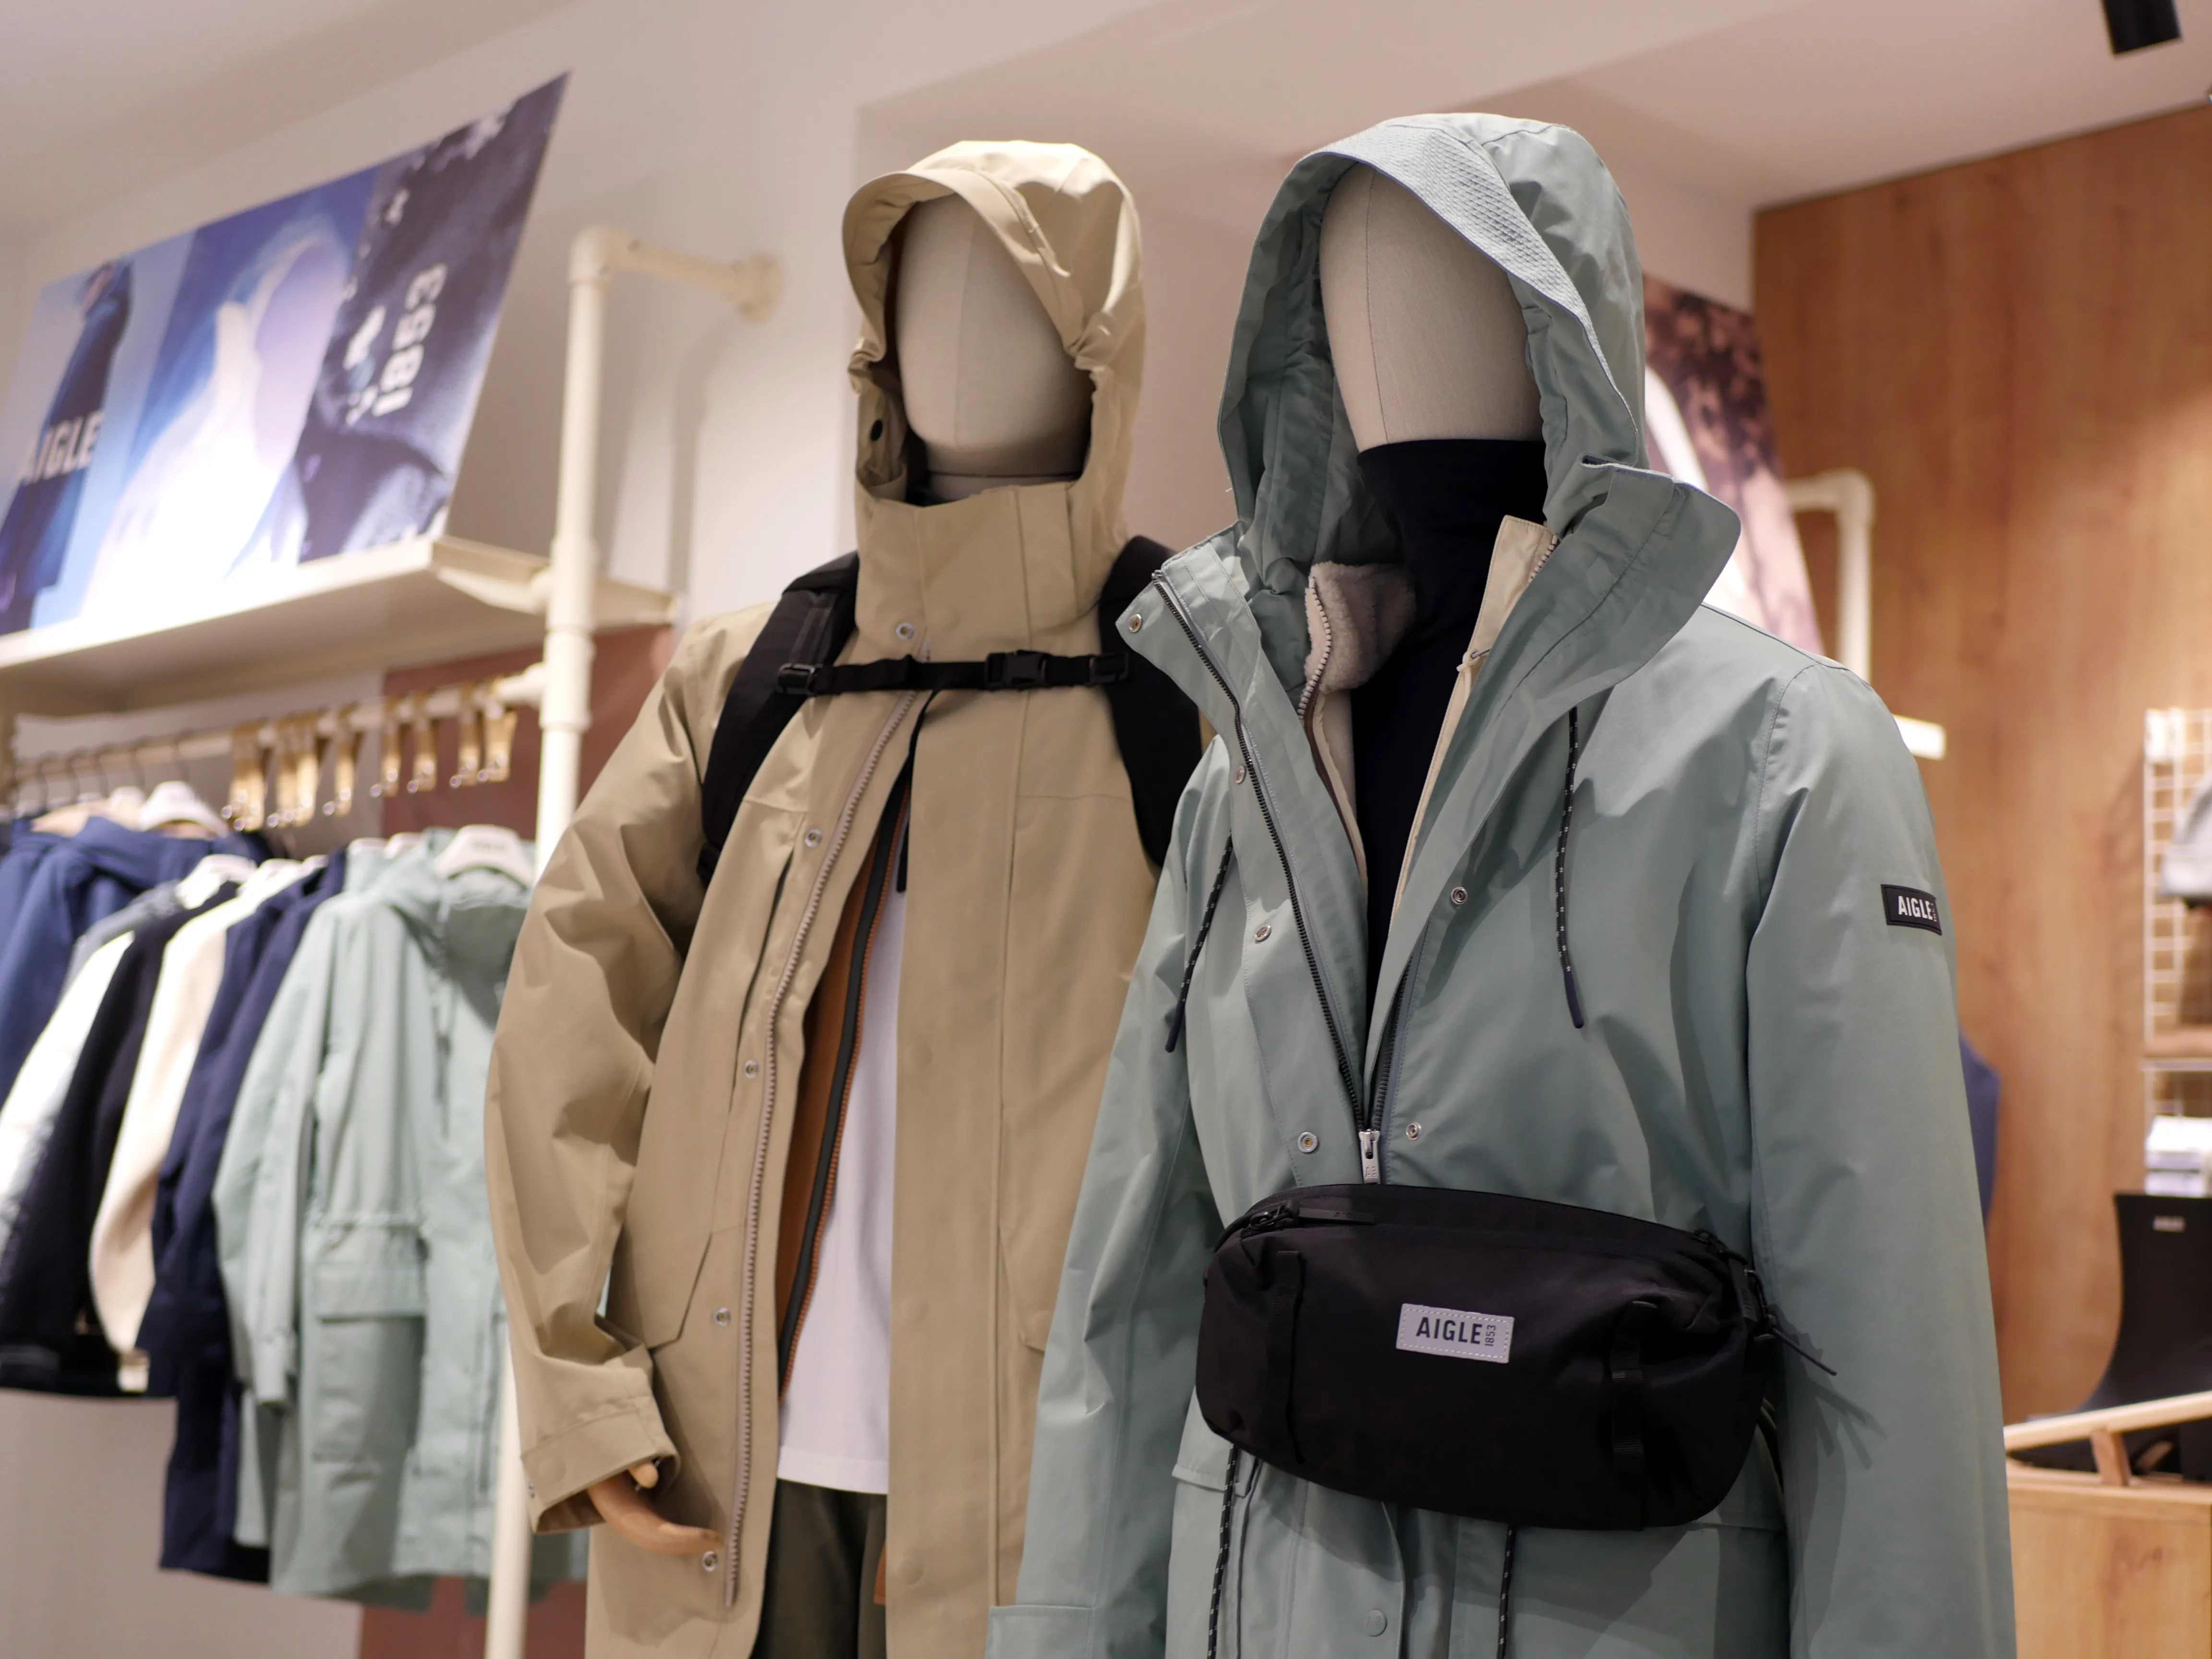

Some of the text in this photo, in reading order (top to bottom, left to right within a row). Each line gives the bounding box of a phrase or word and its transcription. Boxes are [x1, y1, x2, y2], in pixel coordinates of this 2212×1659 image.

[372, 262, 448, 418] 1853
[1898, 895, 1933, 920] AIGLE
[1416, 1316, 1483, 1345] AIGLE
[1484, 1324, 1496, 1346] 1853
